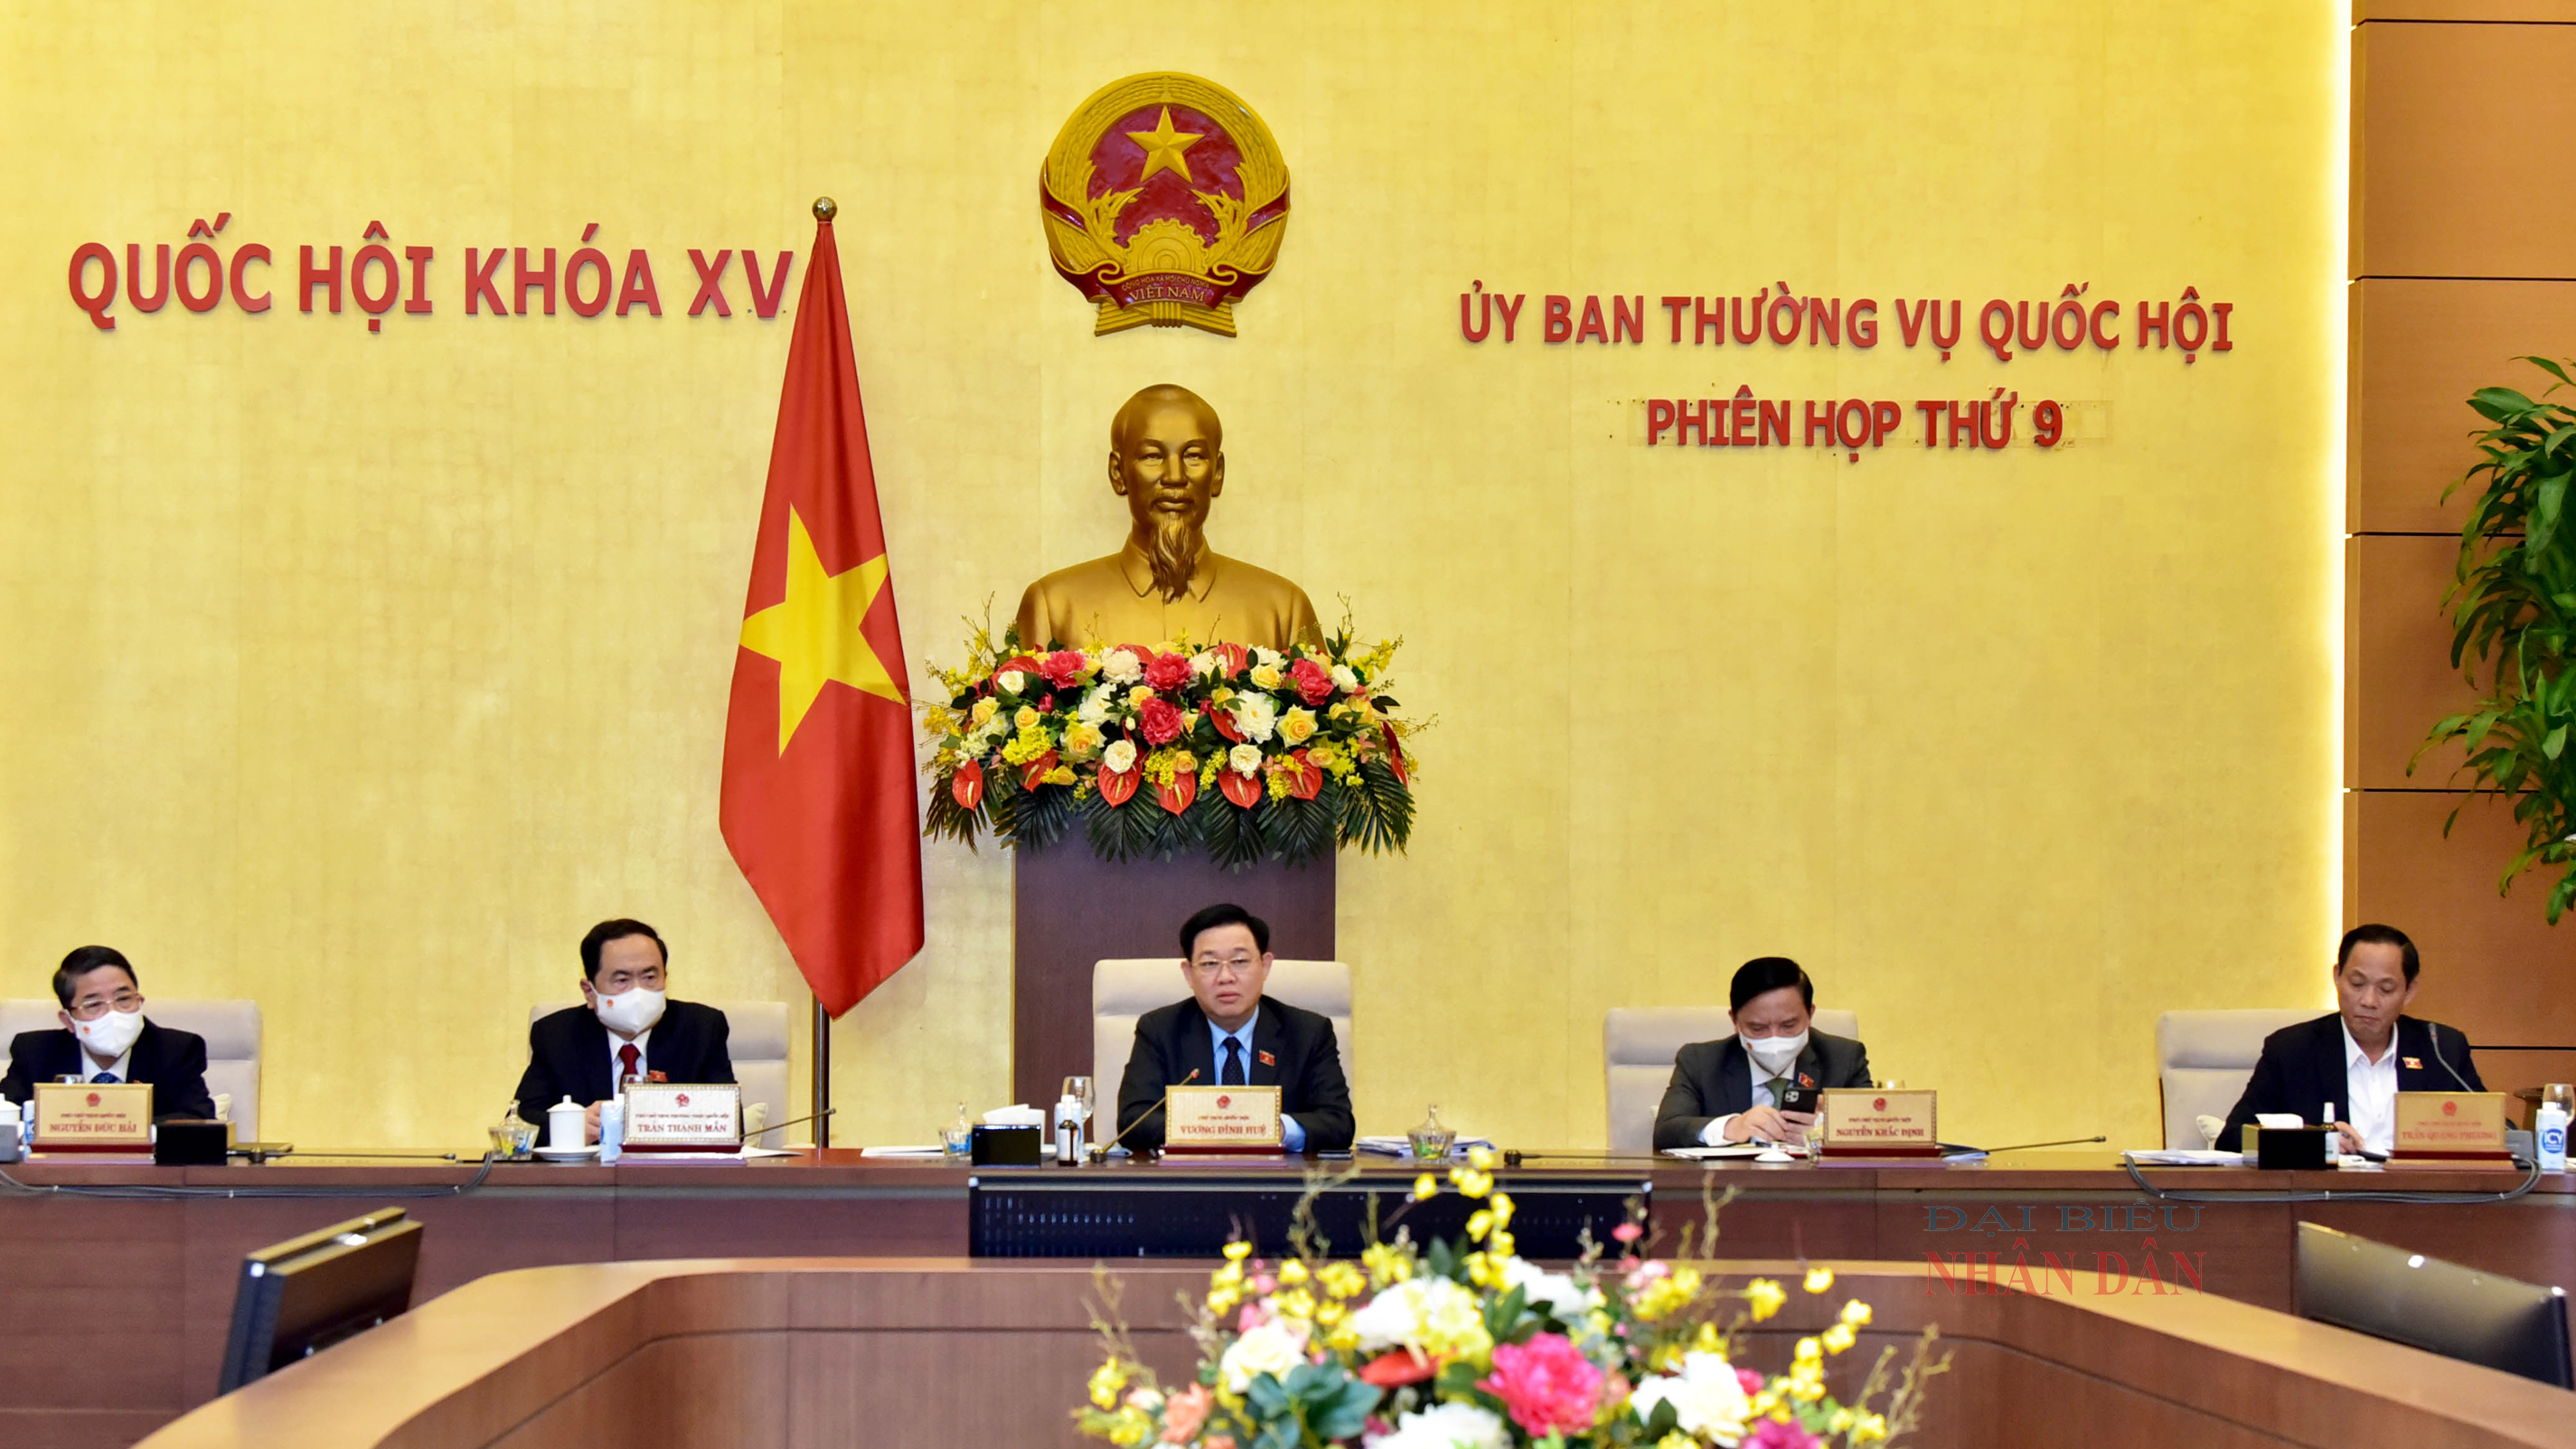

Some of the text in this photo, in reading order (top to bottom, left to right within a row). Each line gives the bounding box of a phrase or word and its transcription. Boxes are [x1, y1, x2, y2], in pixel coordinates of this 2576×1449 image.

[69, 212, 794, 332] QUỐC HỘI KHÓA XV
[1167, 286, 1206, 302] NAM
[1462, 279, 2233, 363] ỦY BAN THƯỜNG VỤ QUỐC HỘI
[1649, 385, 2064, 463] PHIÊN HỌP THỨ 9
[668, 1124, 701, 1133] THANH
[2544, 1132, 2563, 1144] ICY
